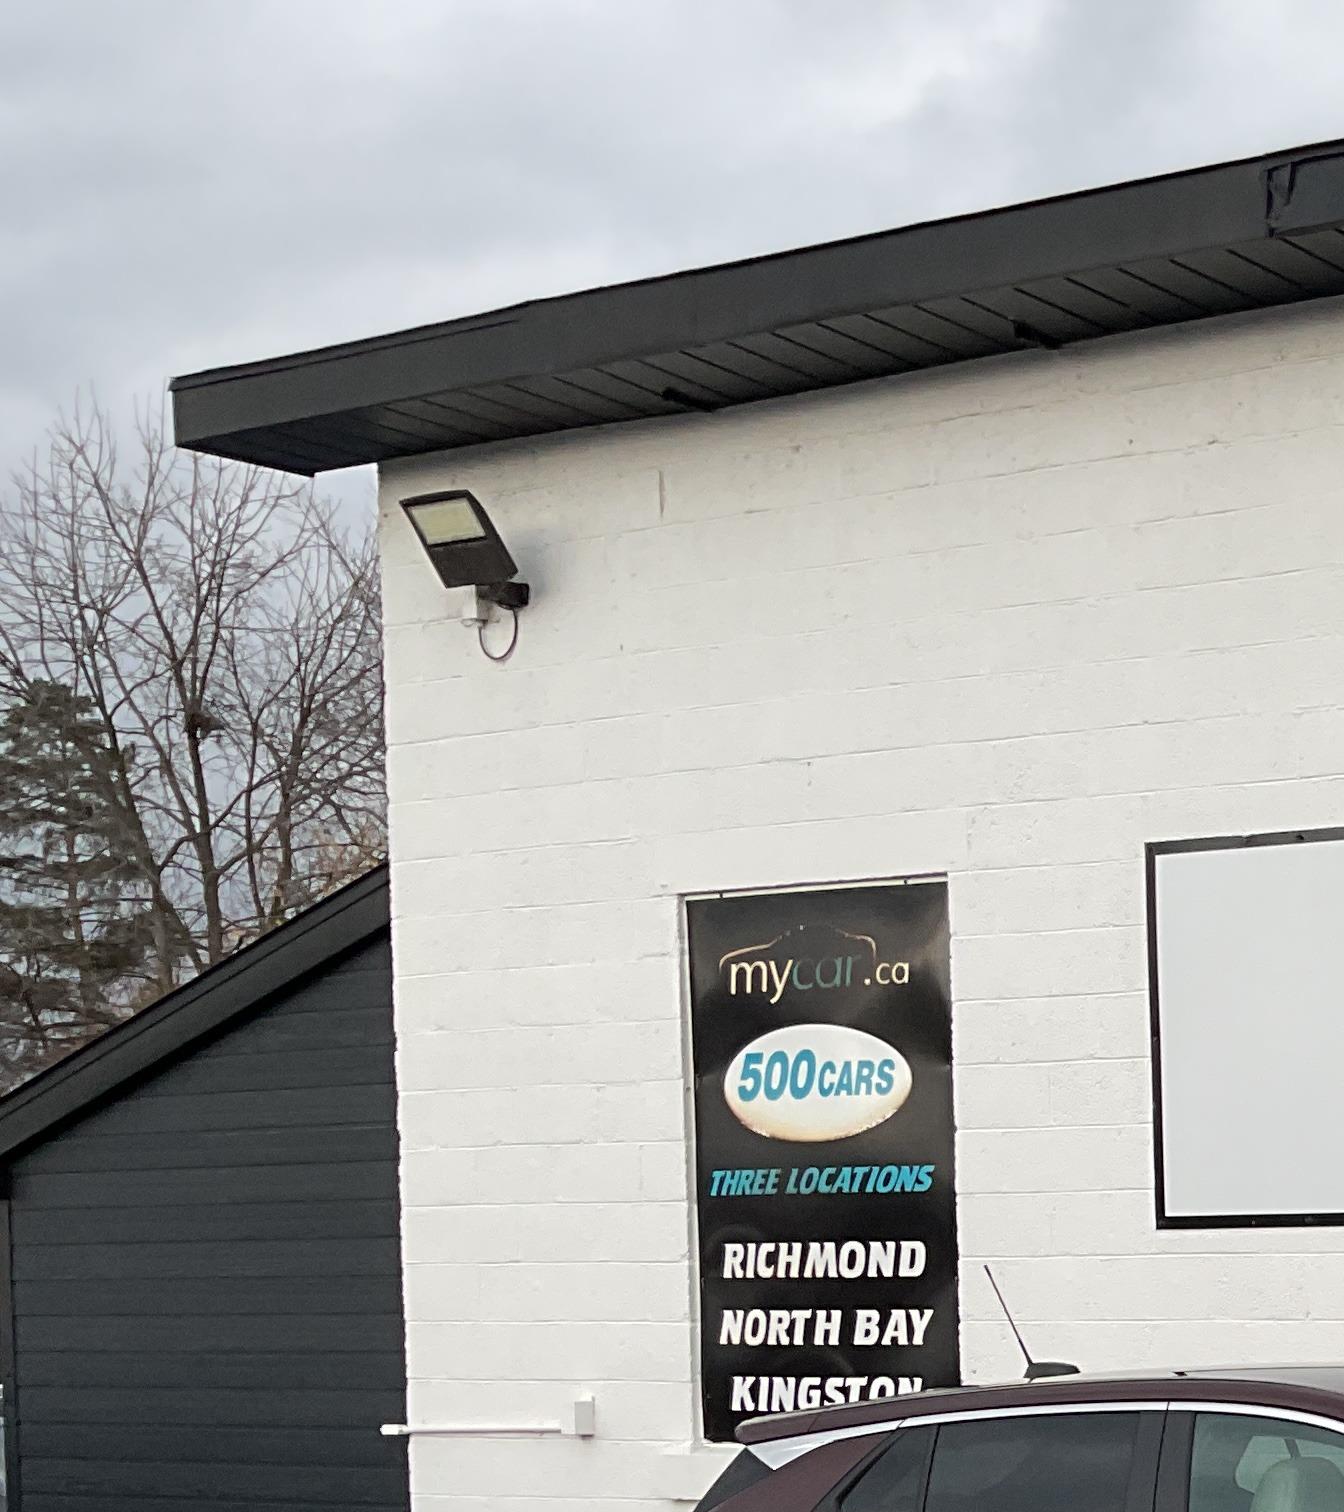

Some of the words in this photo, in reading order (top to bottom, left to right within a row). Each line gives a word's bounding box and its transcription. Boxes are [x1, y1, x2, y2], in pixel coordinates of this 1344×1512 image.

[737, 1048, 816, 1102] 500
[817, 1058, 896, 1098] CARS
[709, 1168, 782, 1197] THREE
[785, 1164, 936, 1196] LOCATIONS
[722, 1240, 927, 1280] RICHMOND
[719, 1308, 842, 1346] NORTH
[853, 1307, 935, 1346] BAY
